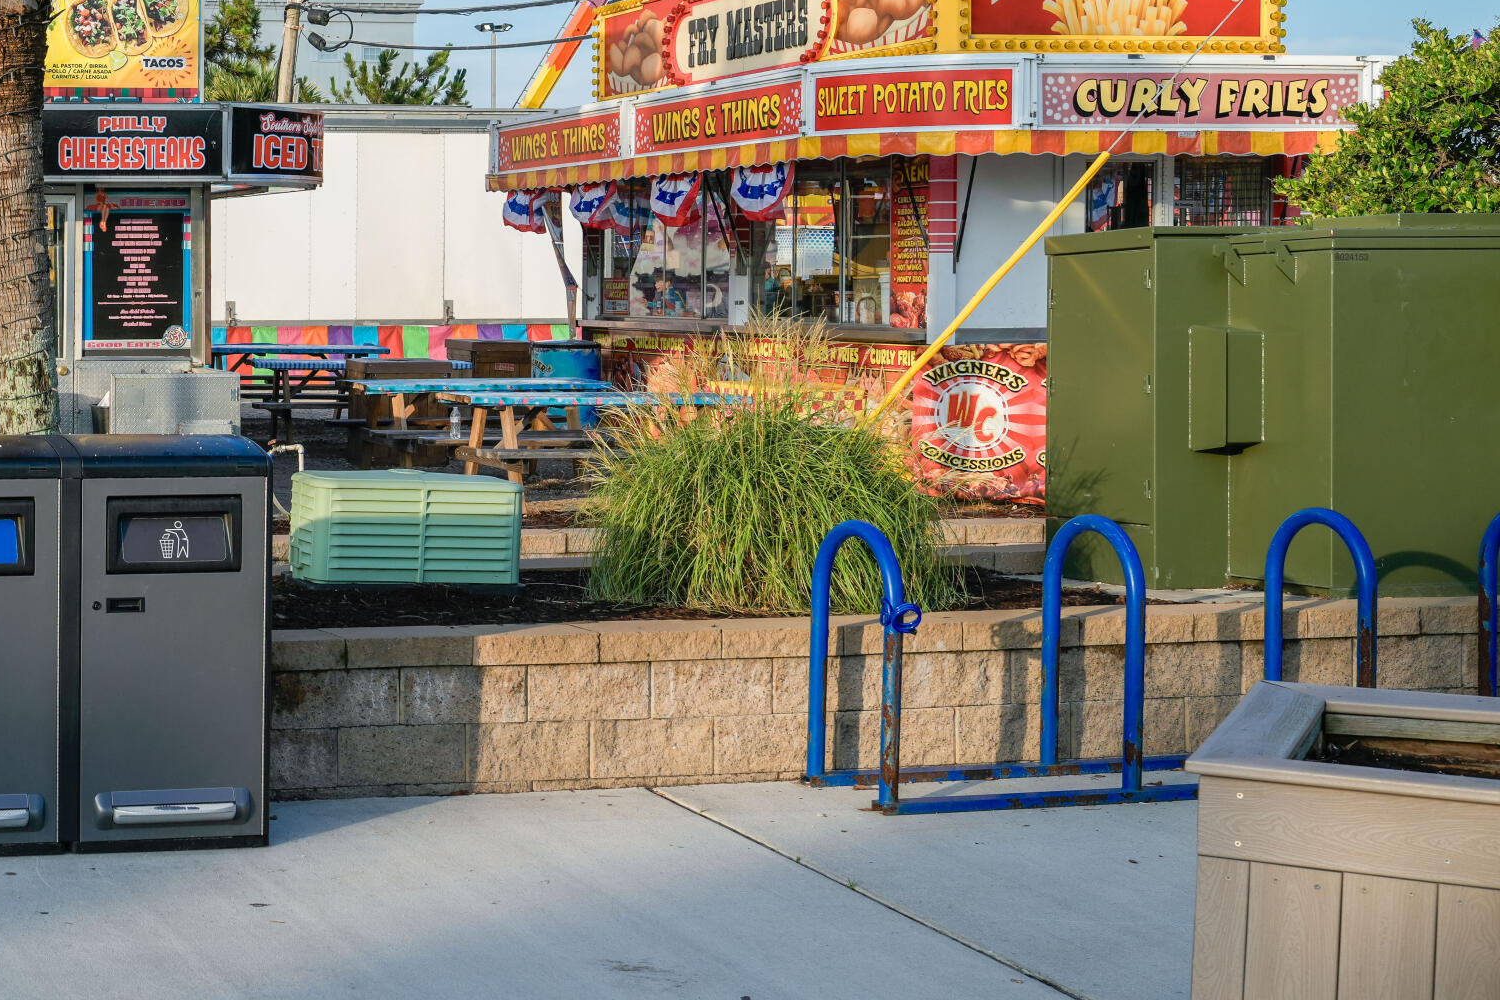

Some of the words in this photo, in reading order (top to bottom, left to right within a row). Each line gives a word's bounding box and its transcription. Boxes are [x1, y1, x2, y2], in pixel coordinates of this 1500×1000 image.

[688, 14, 719, 68] FRY
[142, 58, 184, 69] TACOS
[817, 84, 868, 118] SWEET
[872, 81, 947, 114] POTATO
[952, 79, 1009, 115] FRIES
[1073, 77, 1209, 119] CURLY
[1215, 78, 1329, 119] FRIES
[97, 115, 167, 133] PHILLY
[260, 111, 301, 133] Southern
[652, 105, 701, 145] WINGS
[704, 104, 717, 138] &
[721, 93, 781, 134] THINGS
[58, 135, 205, 170] CHEESESTEAKS
[253, 134, 308, 170] ICED
[511, 129, 547, 162] WINGS
[550, 133, 559, 157] &
[562, 122, 607, 155] THINGS
[120, 198, 186, 207] MENU
[896, 275, 911, 283] HONEY
[897, 263, 905, 271] HOT
[907, 263, 922, 271] WINGS
[869, 349, 896, 365] CURLY
[898, 350, 916, 366] FRIE
[922, 360, 1028, 392] WAGNER'S
